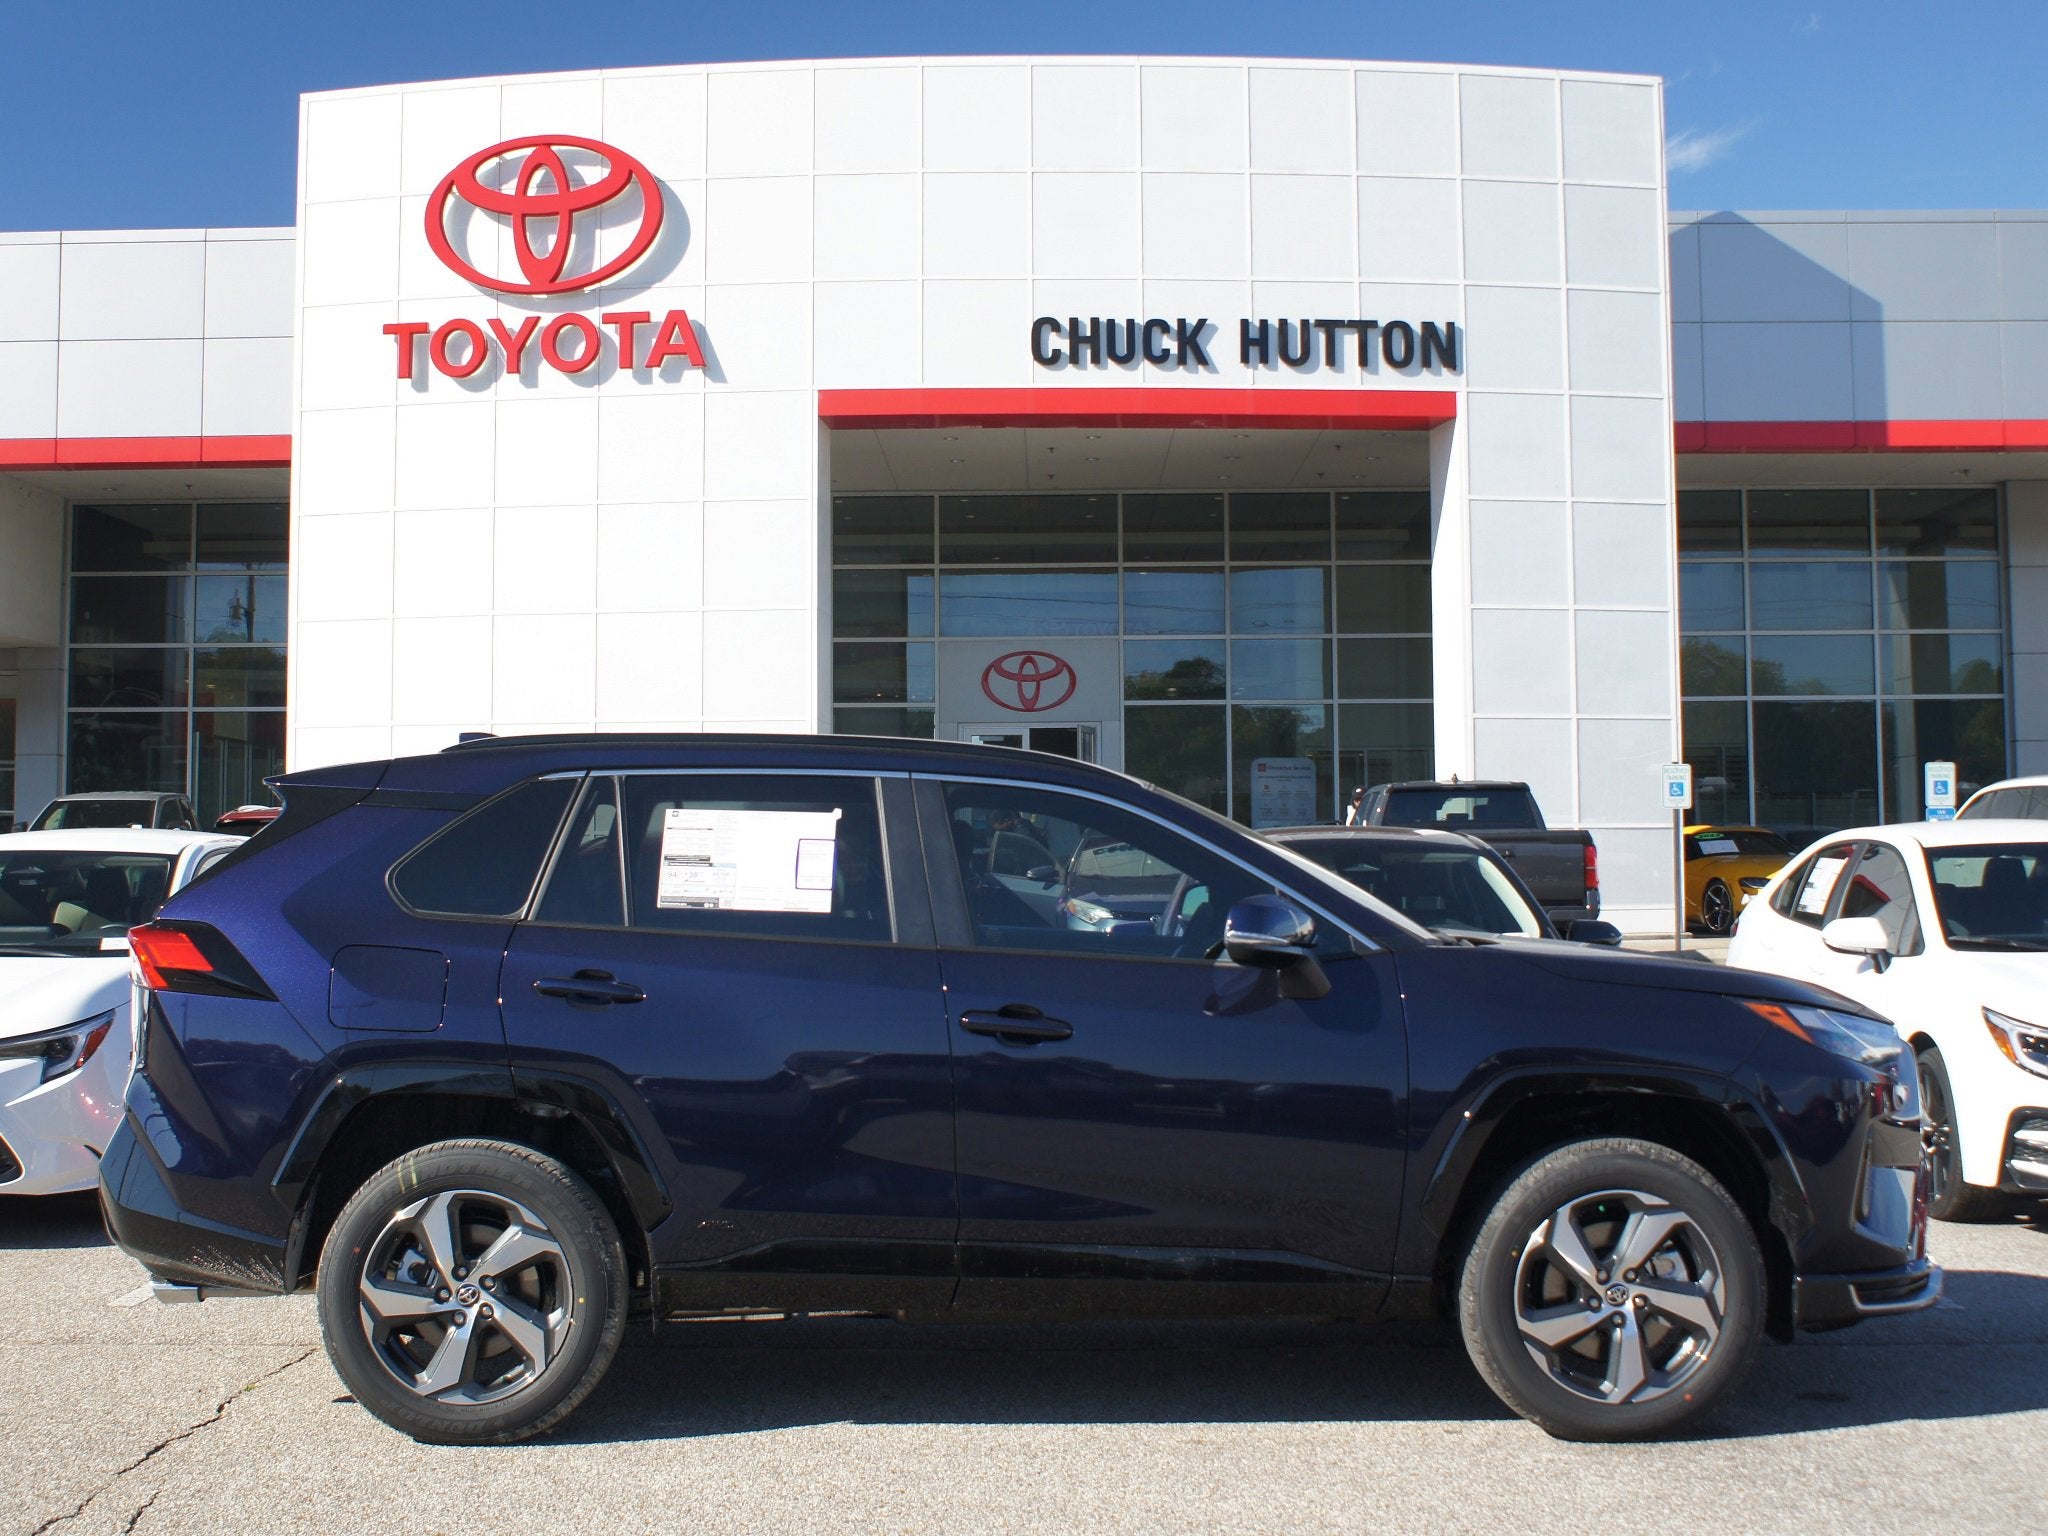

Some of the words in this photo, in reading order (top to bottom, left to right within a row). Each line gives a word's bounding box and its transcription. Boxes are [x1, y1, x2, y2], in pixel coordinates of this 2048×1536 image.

[383, 310, 707, 379] TOYOTA
[1031, 316, 1210, 366] CHUCK
[1240, 318, 1457, 371] HUTTON
